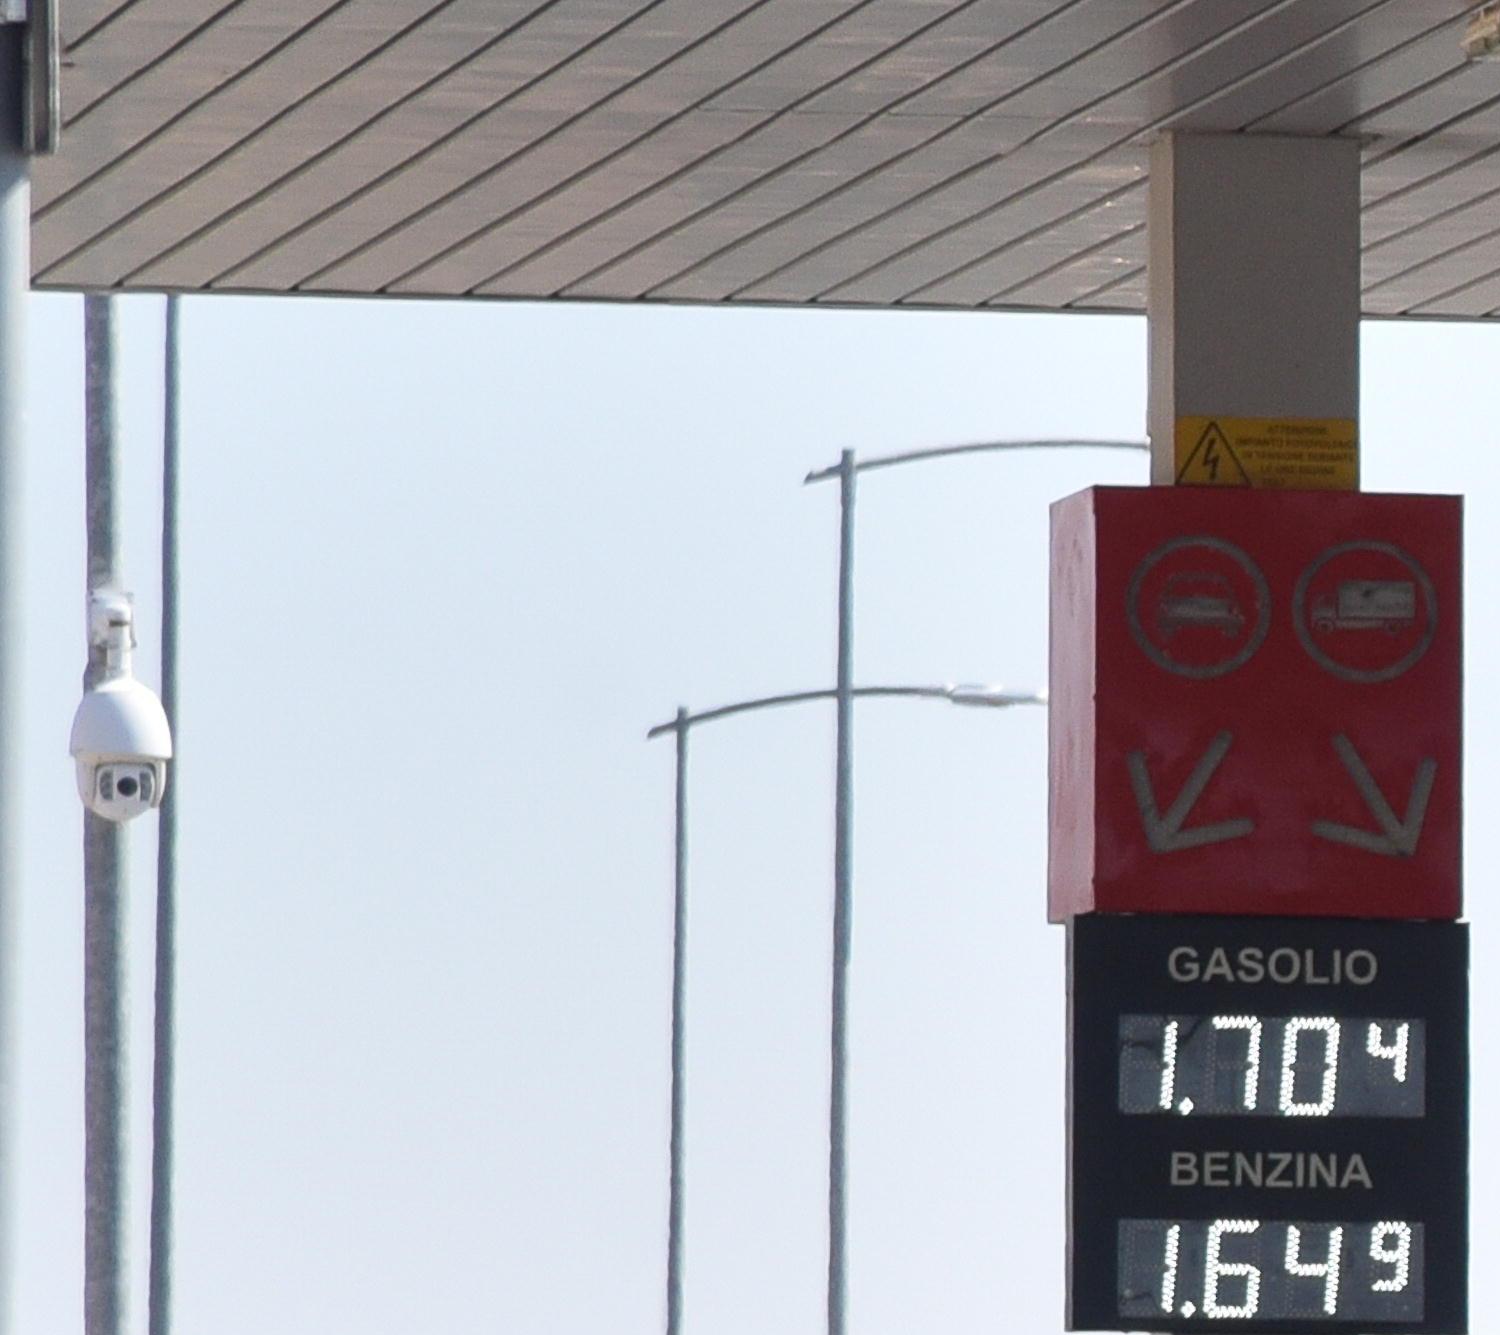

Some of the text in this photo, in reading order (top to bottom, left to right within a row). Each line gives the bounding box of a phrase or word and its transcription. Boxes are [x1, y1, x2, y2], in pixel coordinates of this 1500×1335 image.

[1169, 947, 1378, 985] GASOLIO
[1160, 1016, 1409, 1116] 1.704
[1171, 1152, 1372, 1188] BENZINA
[1162, 1219, 1411, 1318] 1.649
